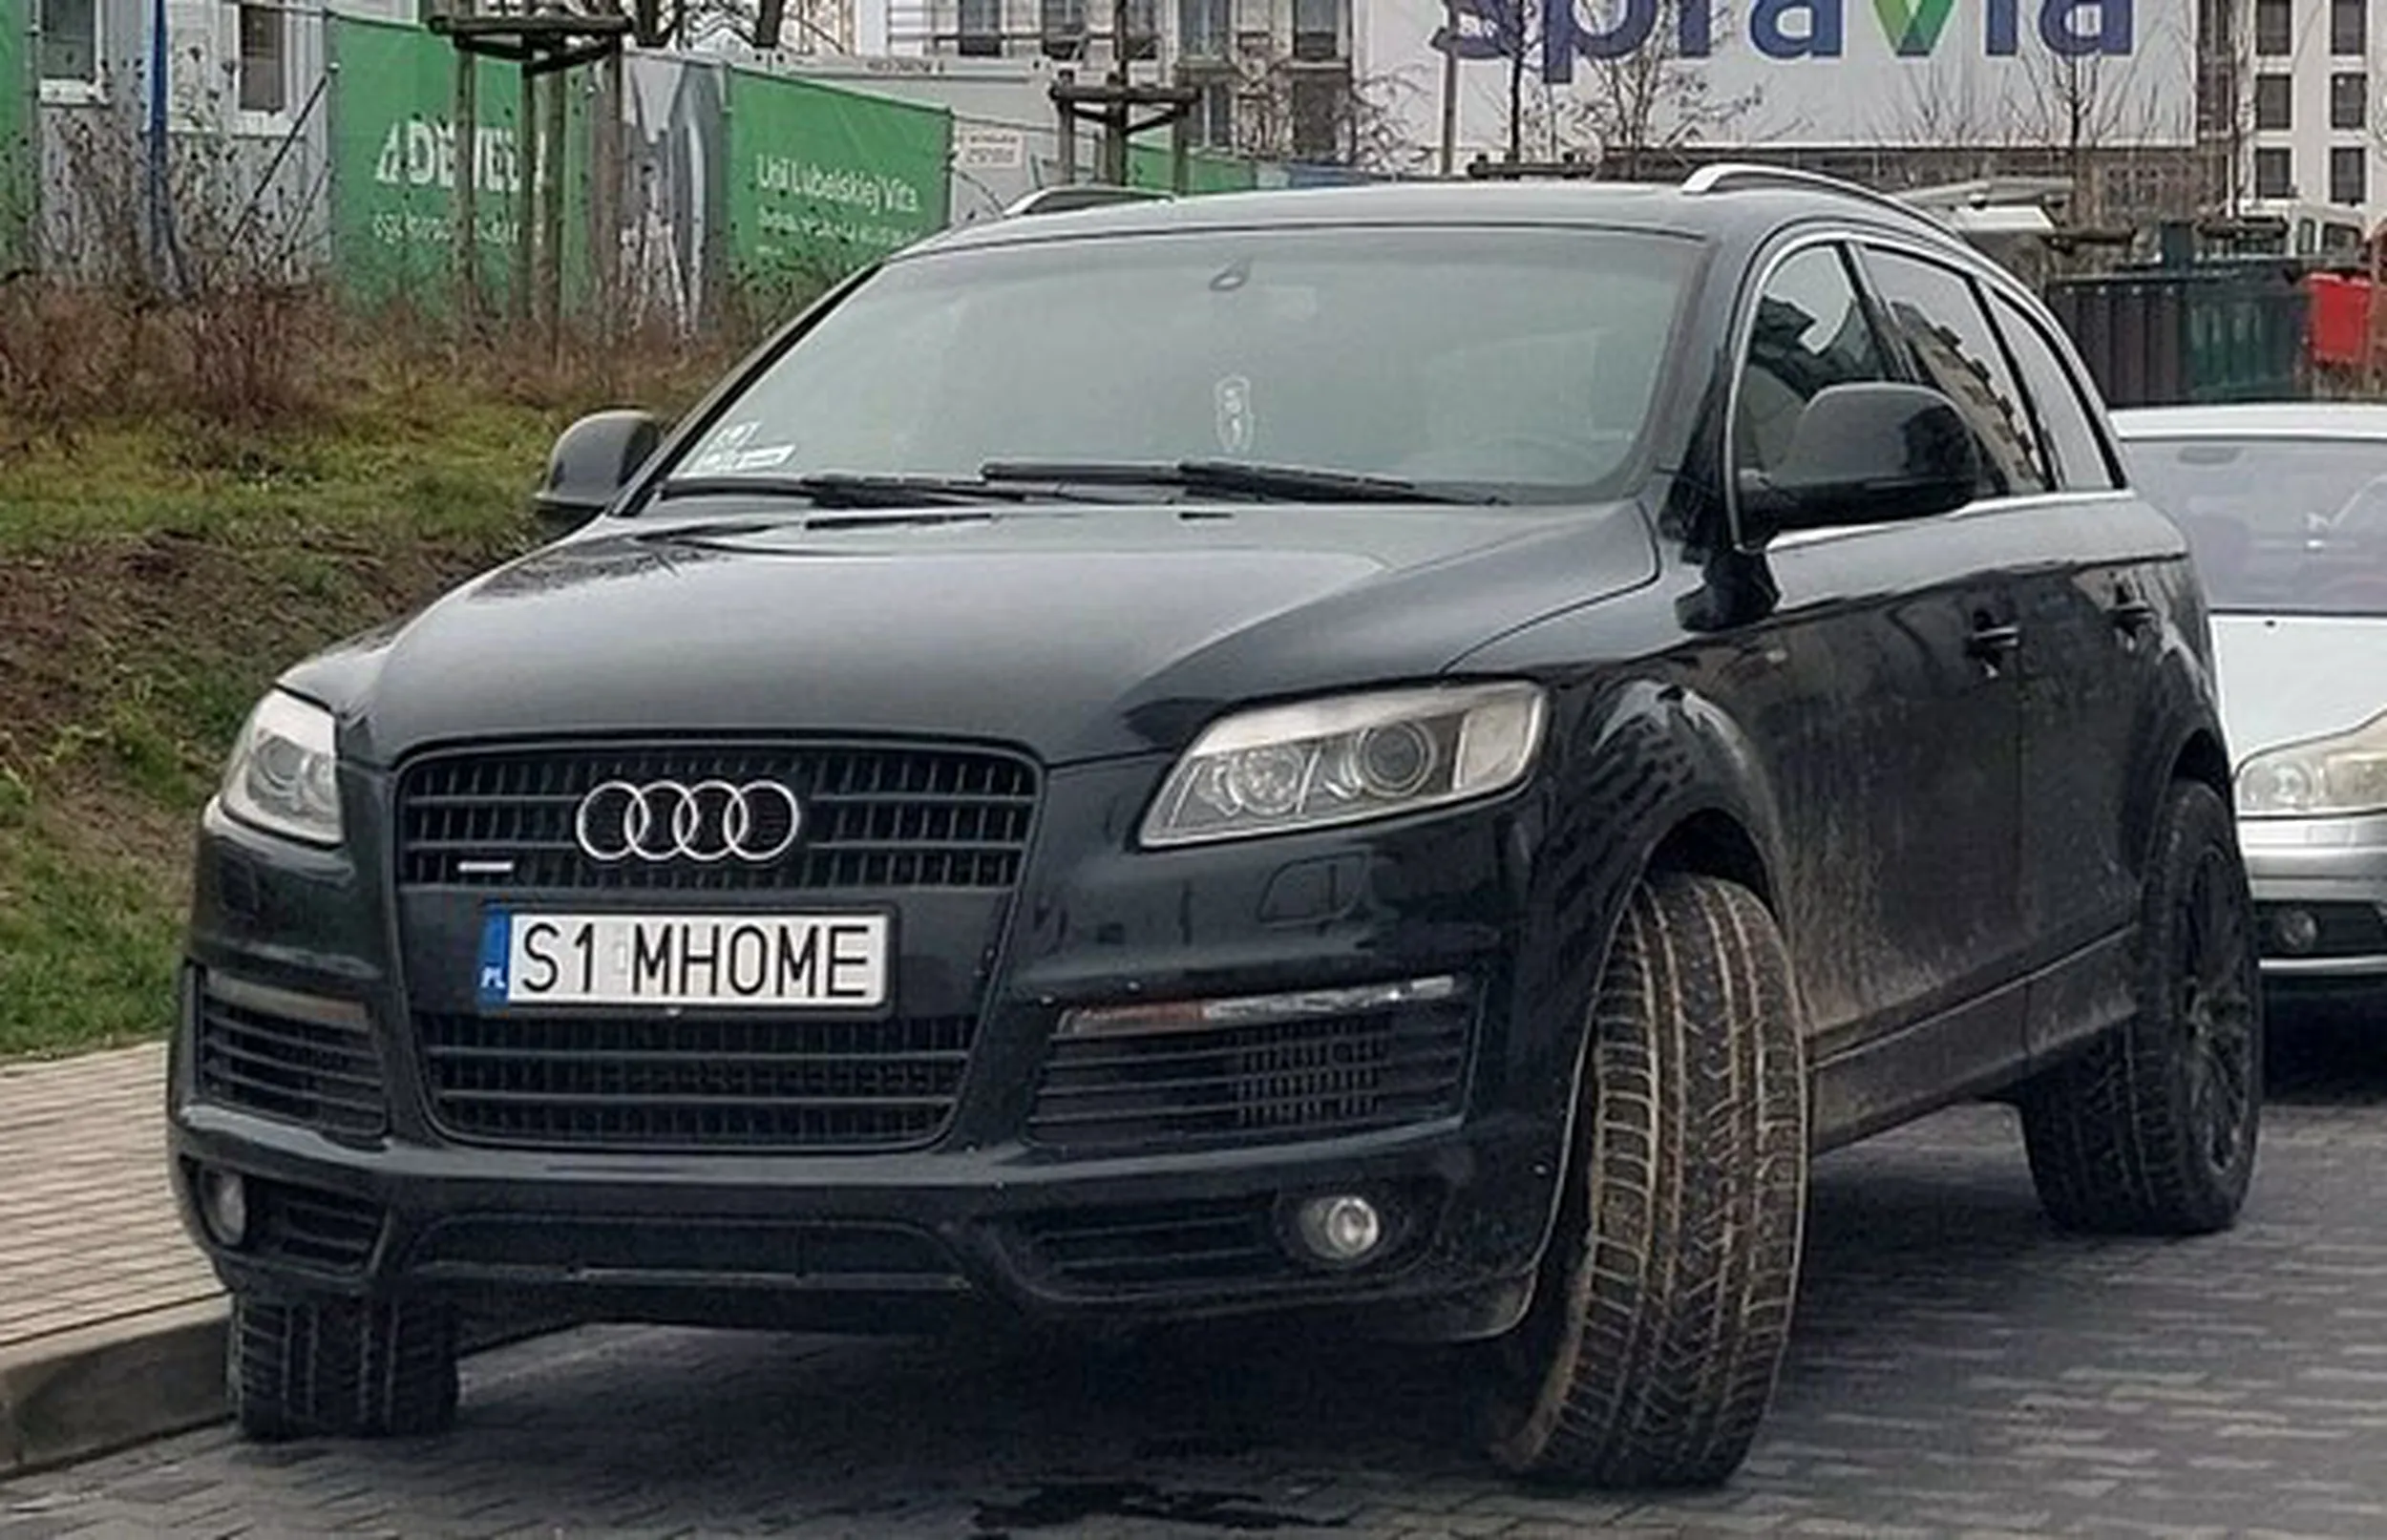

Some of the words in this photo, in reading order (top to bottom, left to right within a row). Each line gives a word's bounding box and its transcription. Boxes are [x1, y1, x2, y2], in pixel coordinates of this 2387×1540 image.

[480, 965, 507, 989] PL
[522, 922, 594, 994] S1
[632, 923, 871, 998] MHOME
